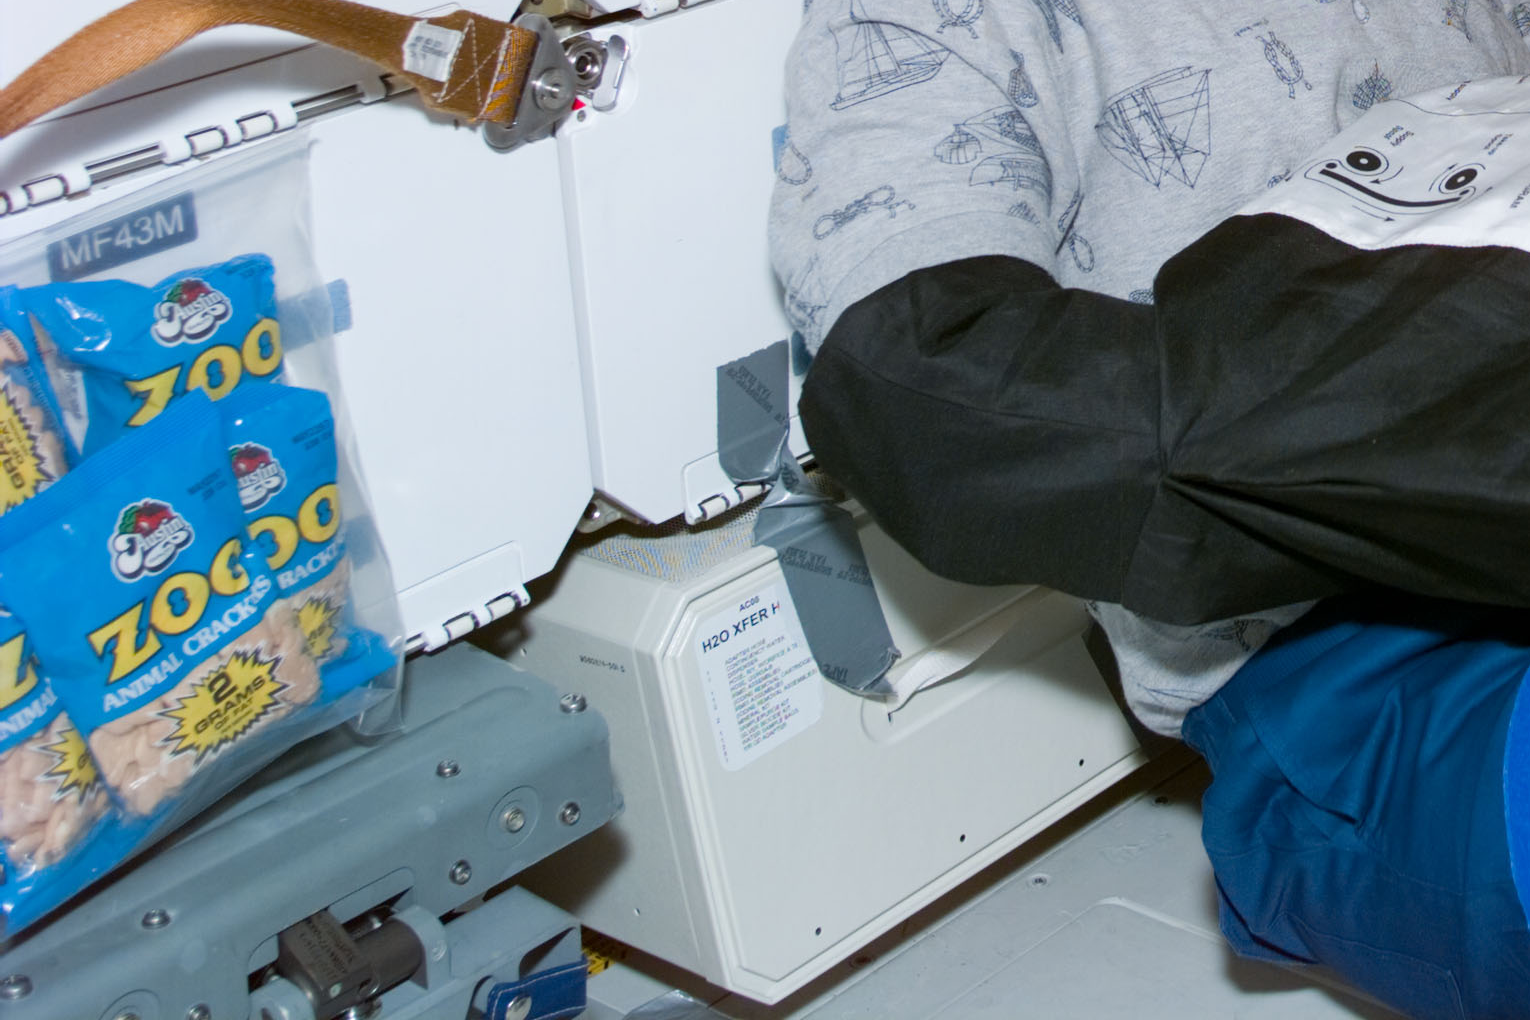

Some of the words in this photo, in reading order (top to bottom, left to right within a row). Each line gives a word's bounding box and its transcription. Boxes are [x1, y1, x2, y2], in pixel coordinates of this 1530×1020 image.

[59, 205, 185, 271] MF43M
[127, 318, 283, 427] ZOO
[702, 629, 730, 654] H2O
[732, 607, 769, 637] XFER
[103, 651, 184, 713] ANIMAL
[194, 674, 266, 735] GRAMS
[208, 671, 233, 706] 2
[213, 714, 233, 731] OF
[232, 697, 256, 720] FAT
